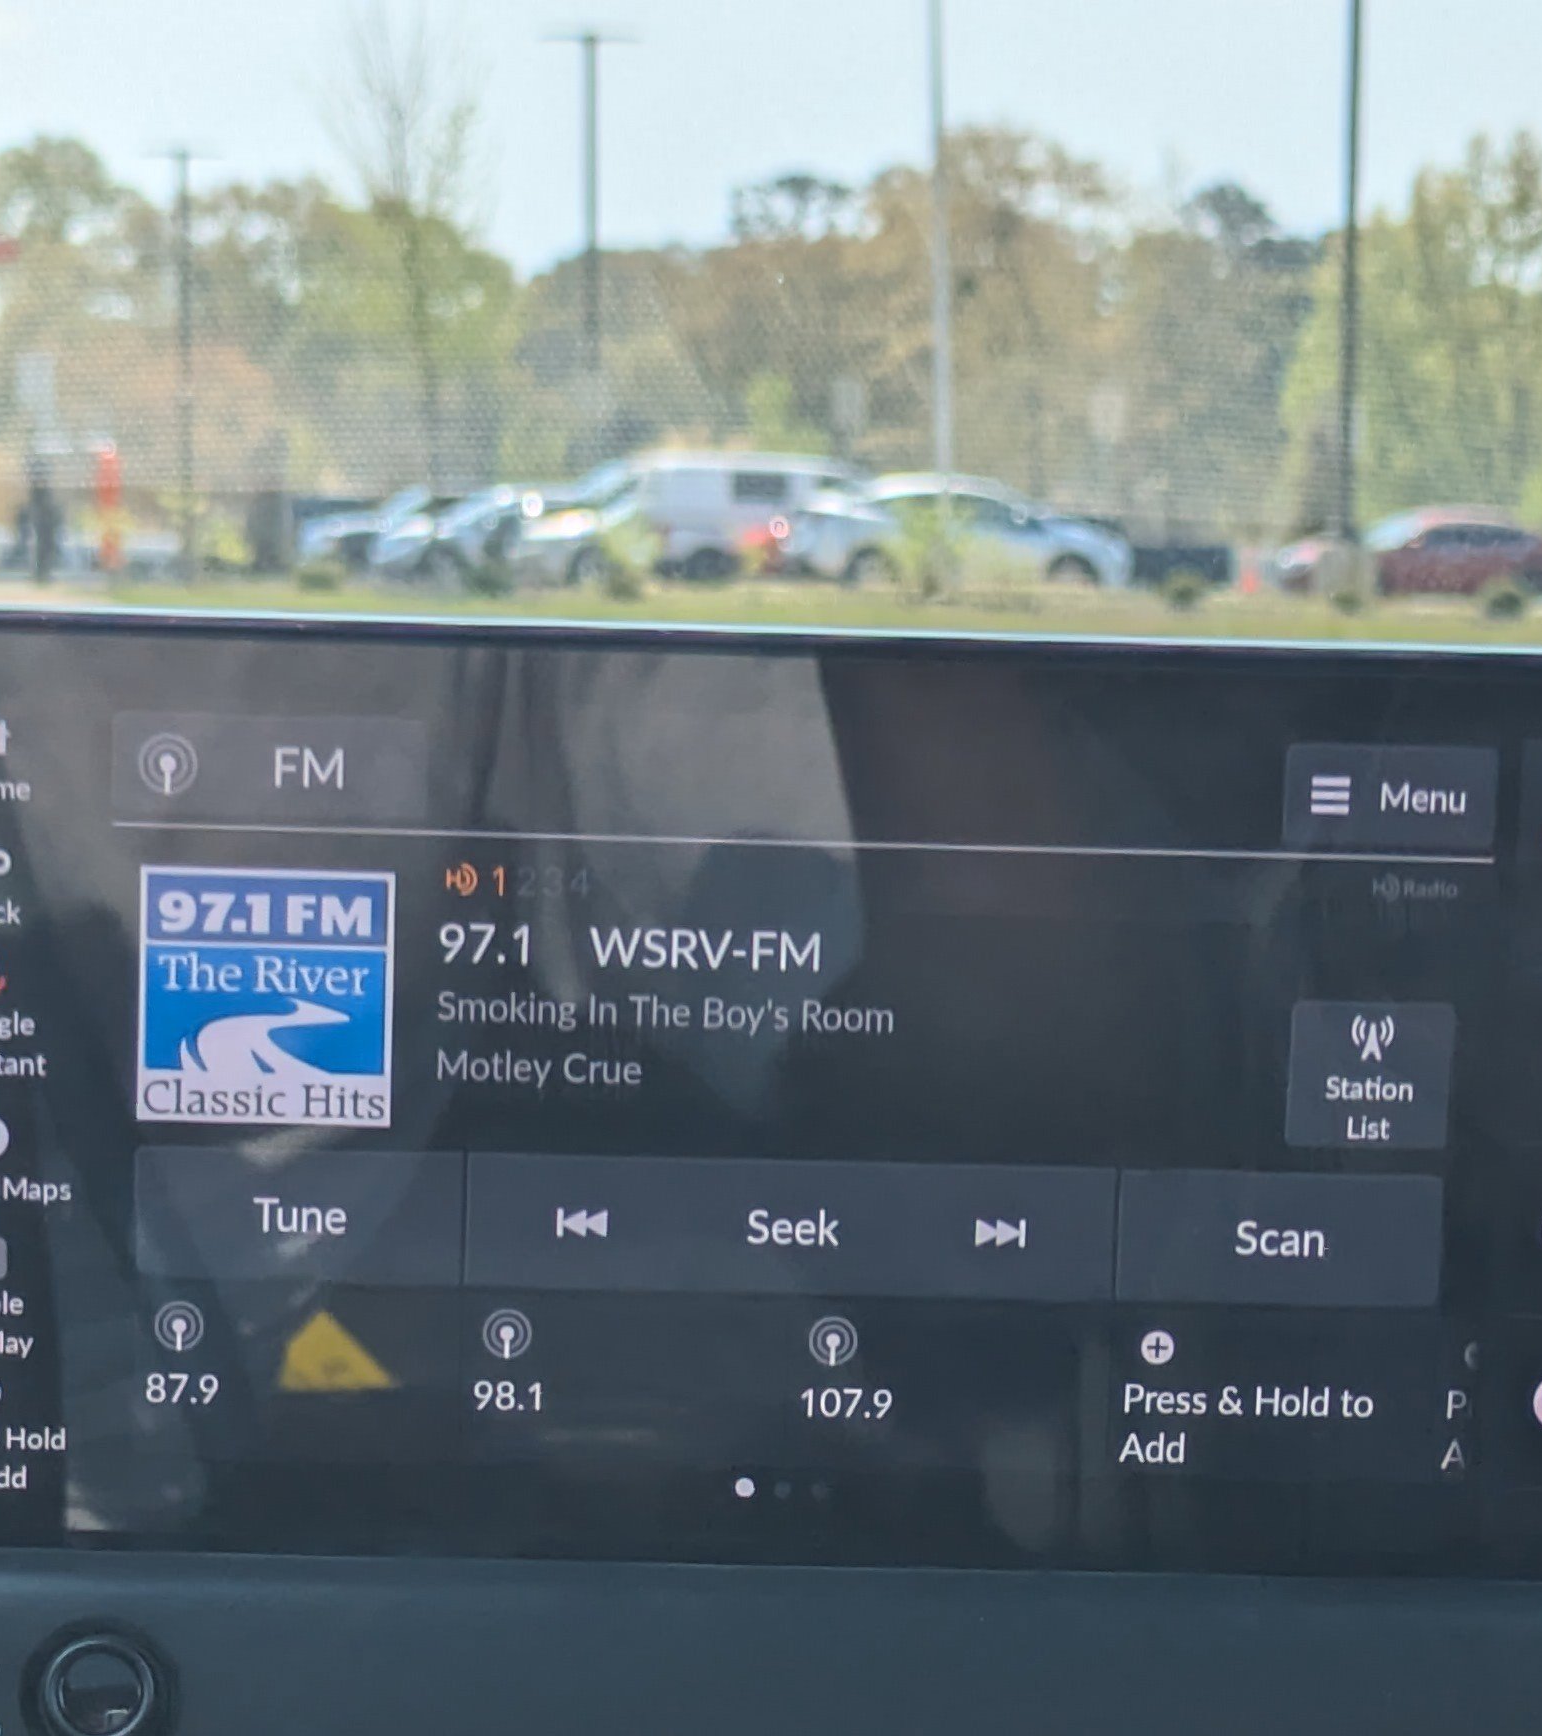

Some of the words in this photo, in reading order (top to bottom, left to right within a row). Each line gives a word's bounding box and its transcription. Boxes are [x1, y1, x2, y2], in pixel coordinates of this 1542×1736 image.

[274, 747, 344, 789] FM
[1380, 782, 1466, 814] Menu
[492, 865, 506, 897] 1
[158, 891, 271, 934] 97.1
[287, 895, 371, 936] FM
[439, 924, 531, 967] 97.1
[590, 927, 822, 973] WSRV-FM
[159, 953, 247, 993] The
[256, 956, 369, 996] River
[438, 992, 576, 1030] Smoking
[589, 996, 618, 1026] In
[629, 995, 691, 1028] The
[703, 999, 789, 1037] Boy's
[802, 1000, 895, 1034] Room
[436, 1049, 552, 1089] Motley
[563, 1053, 642, 1086] Crue
[142, 1081, 285, 1118] Classic
[302, 1084, 386, 1120] Hits
[1325, 1076, 1414, 1102] Station
[1347, 1115, 1389, 1140] List
[4, 1178, 71, 1204] Maps
[253, 1198, 347, 1235] Tune
[747, 1209, 839, 1247] Seek
[1234, 1220, 1325, 1257] Scan
[145, 1375, 219, 1405] 87.9
[474, 1381, 542, 1411] 98.1
[801, 1388, 893, 1420] 107.9
[1123, 1383, 1206, 1415] Press
[1218, 1386, 1243, 1416] &
[1255, 1386, 1330, 1417] Hold
[1341, 1389, 1374, 1419] to
[6, 1428, 66, 1452] Hold
[1119, 1432, 1186, 1463] Add
